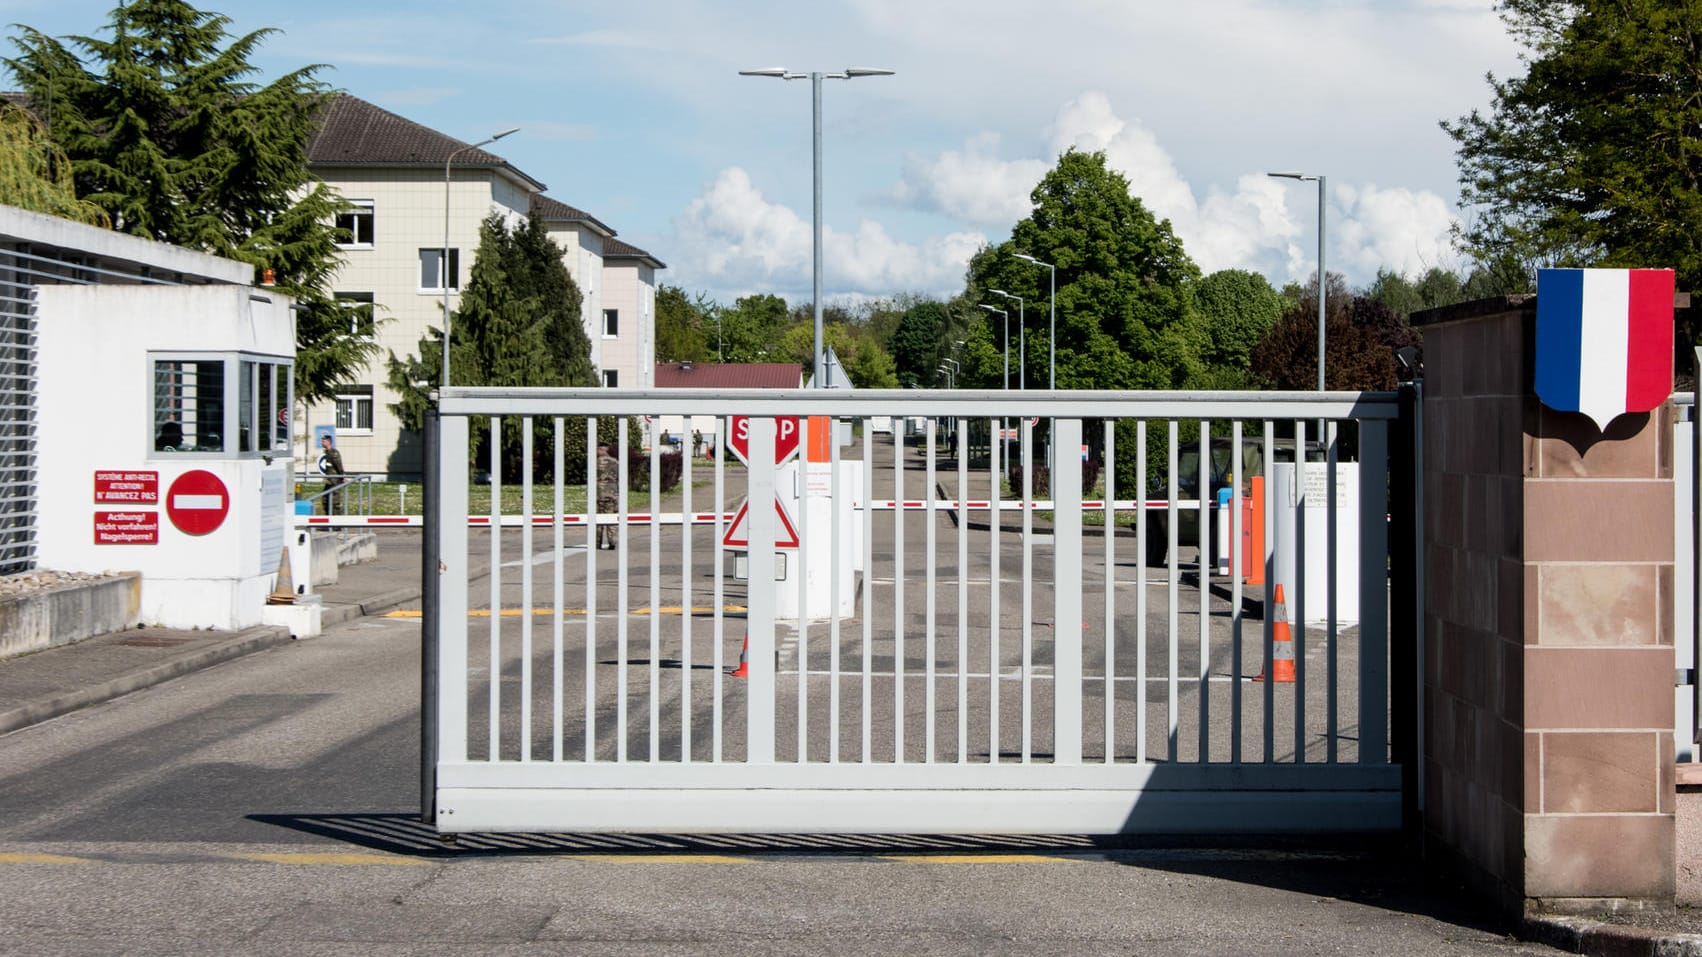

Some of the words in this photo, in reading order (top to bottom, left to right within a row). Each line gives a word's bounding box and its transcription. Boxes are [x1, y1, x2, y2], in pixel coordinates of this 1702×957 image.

[737, 419, 795, 441] SP
[140, 491, 156, 500] PAS
[96, 522, 116, 531] Nicht
